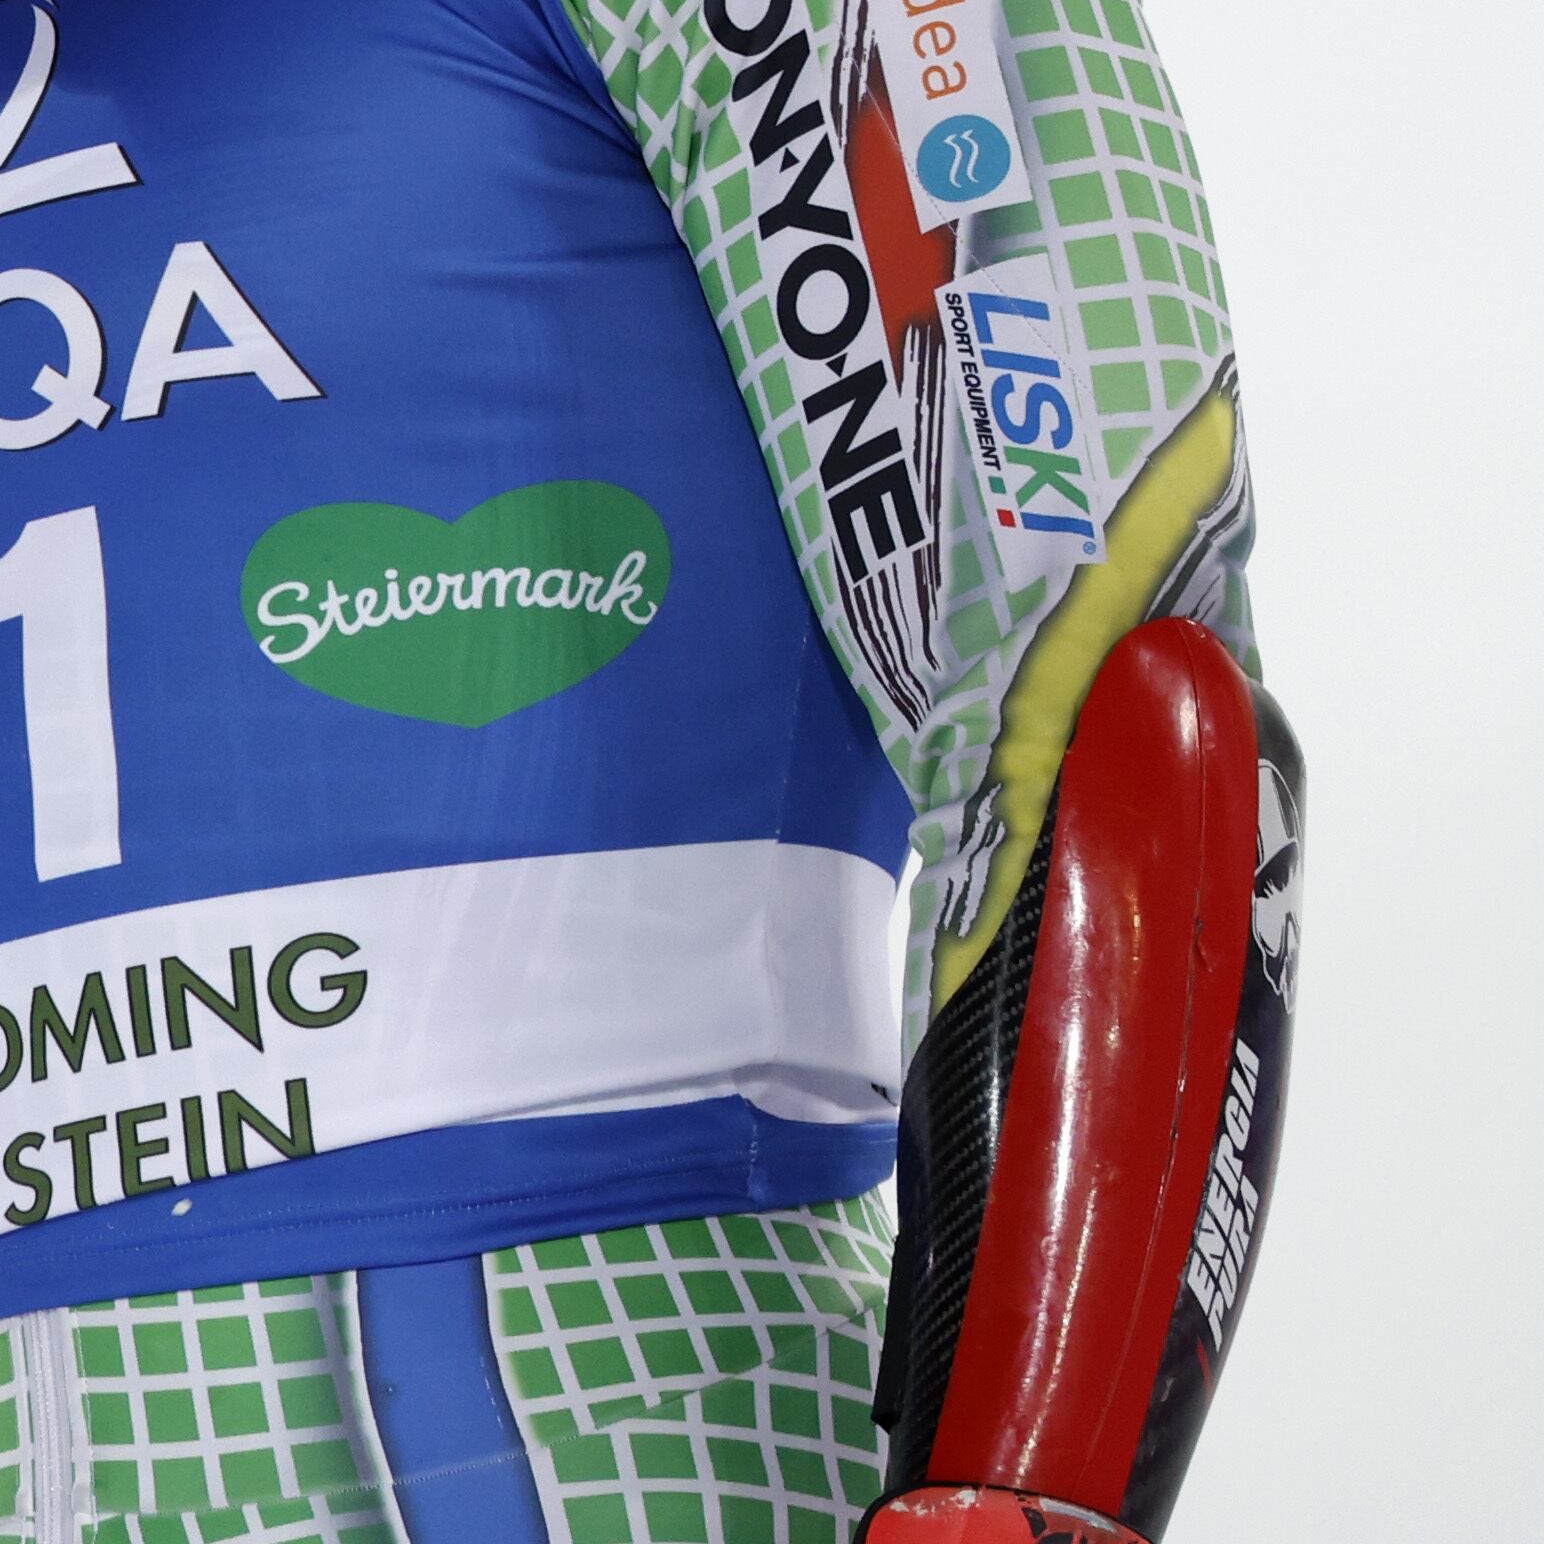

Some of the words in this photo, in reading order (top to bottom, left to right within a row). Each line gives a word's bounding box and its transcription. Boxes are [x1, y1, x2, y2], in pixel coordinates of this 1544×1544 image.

[945, 292, 974, 358] SPORT
[960, 360, 1001, 471] EQUIPMENT
[257, 549, 660, 664] Steiermark
[1186, 1037, 1260, 1318] ENERGIA
[1208, 1174, 1259, 1353] PURA
